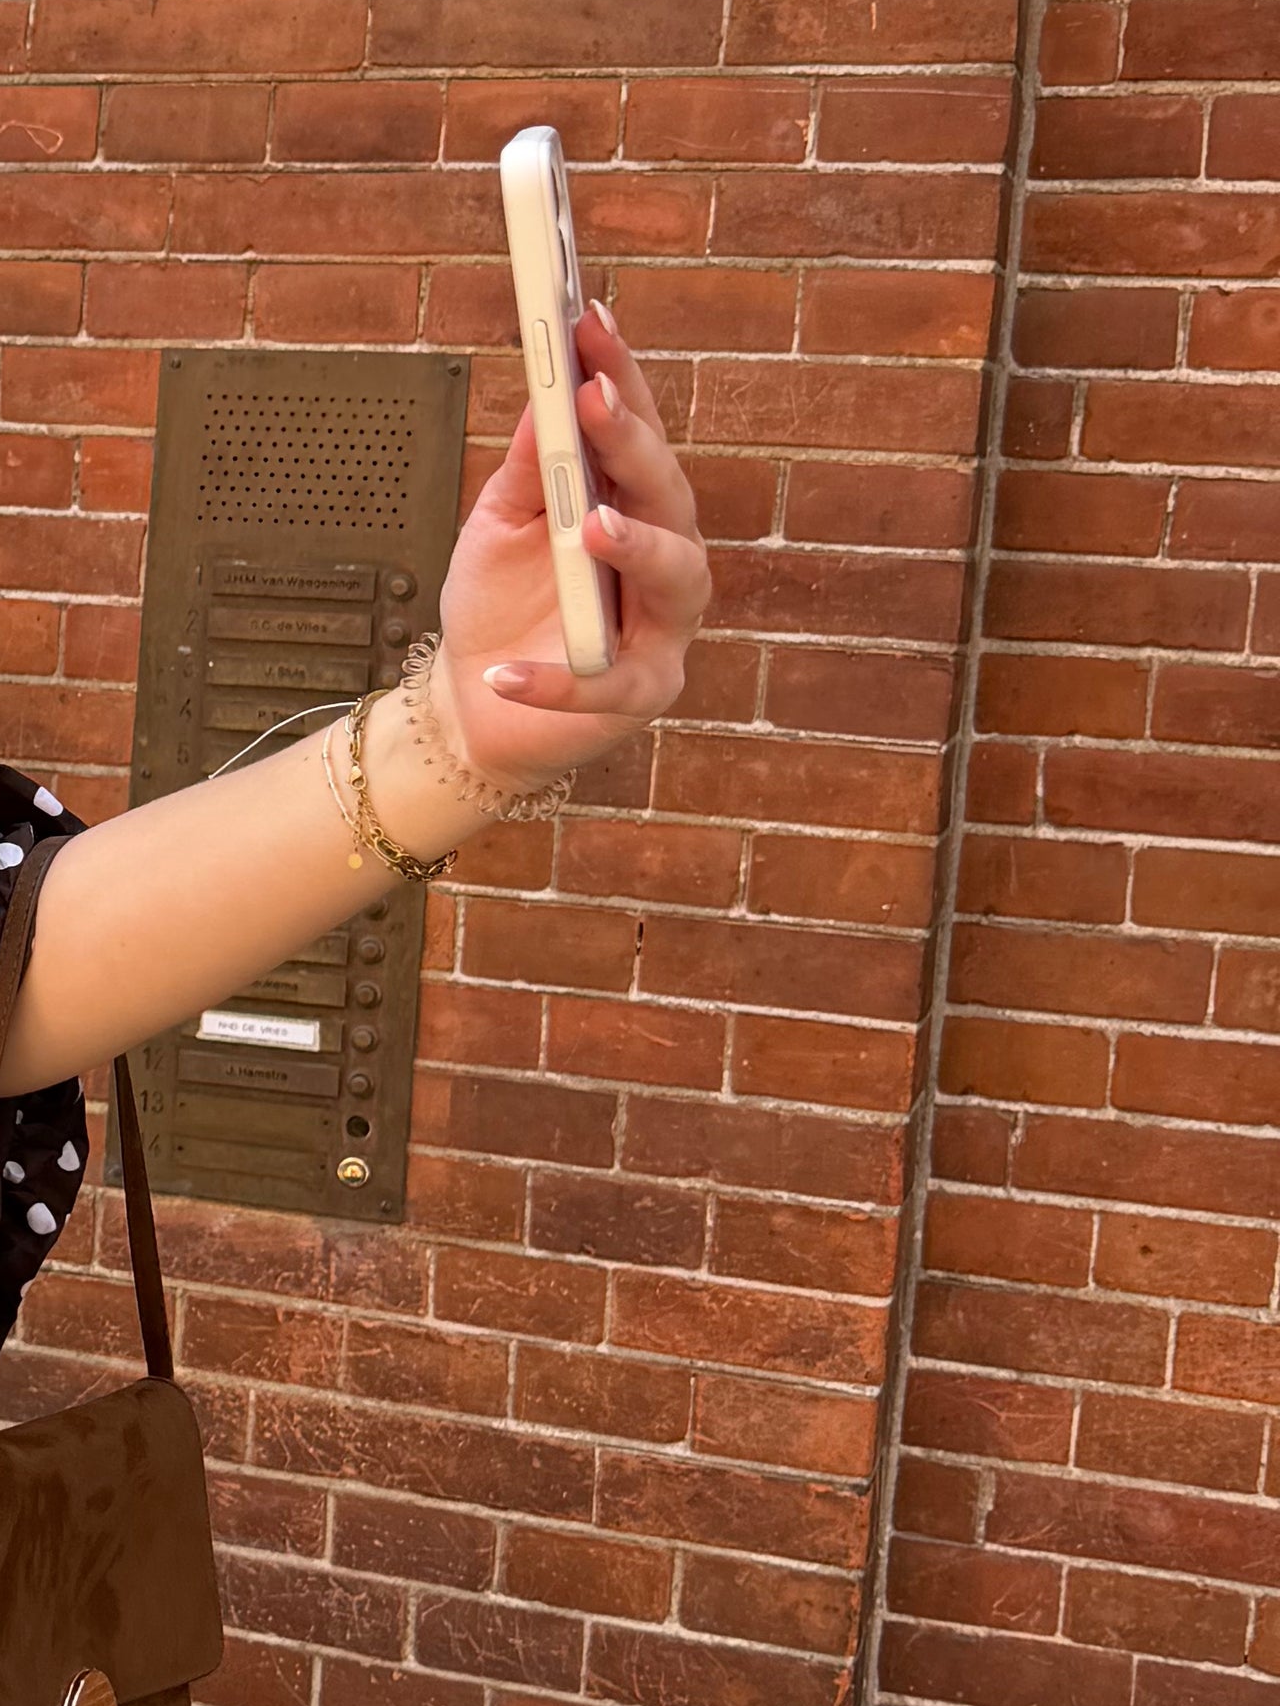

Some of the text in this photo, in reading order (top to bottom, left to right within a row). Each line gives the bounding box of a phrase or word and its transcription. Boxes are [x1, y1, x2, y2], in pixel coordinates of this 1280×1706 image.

[262, 575, 284, 586] van
[142, 1046, 166, 1072] 12
[239, 1066, 289, 1082] Hamstra
[140, 1089, 165, 1114] 13
